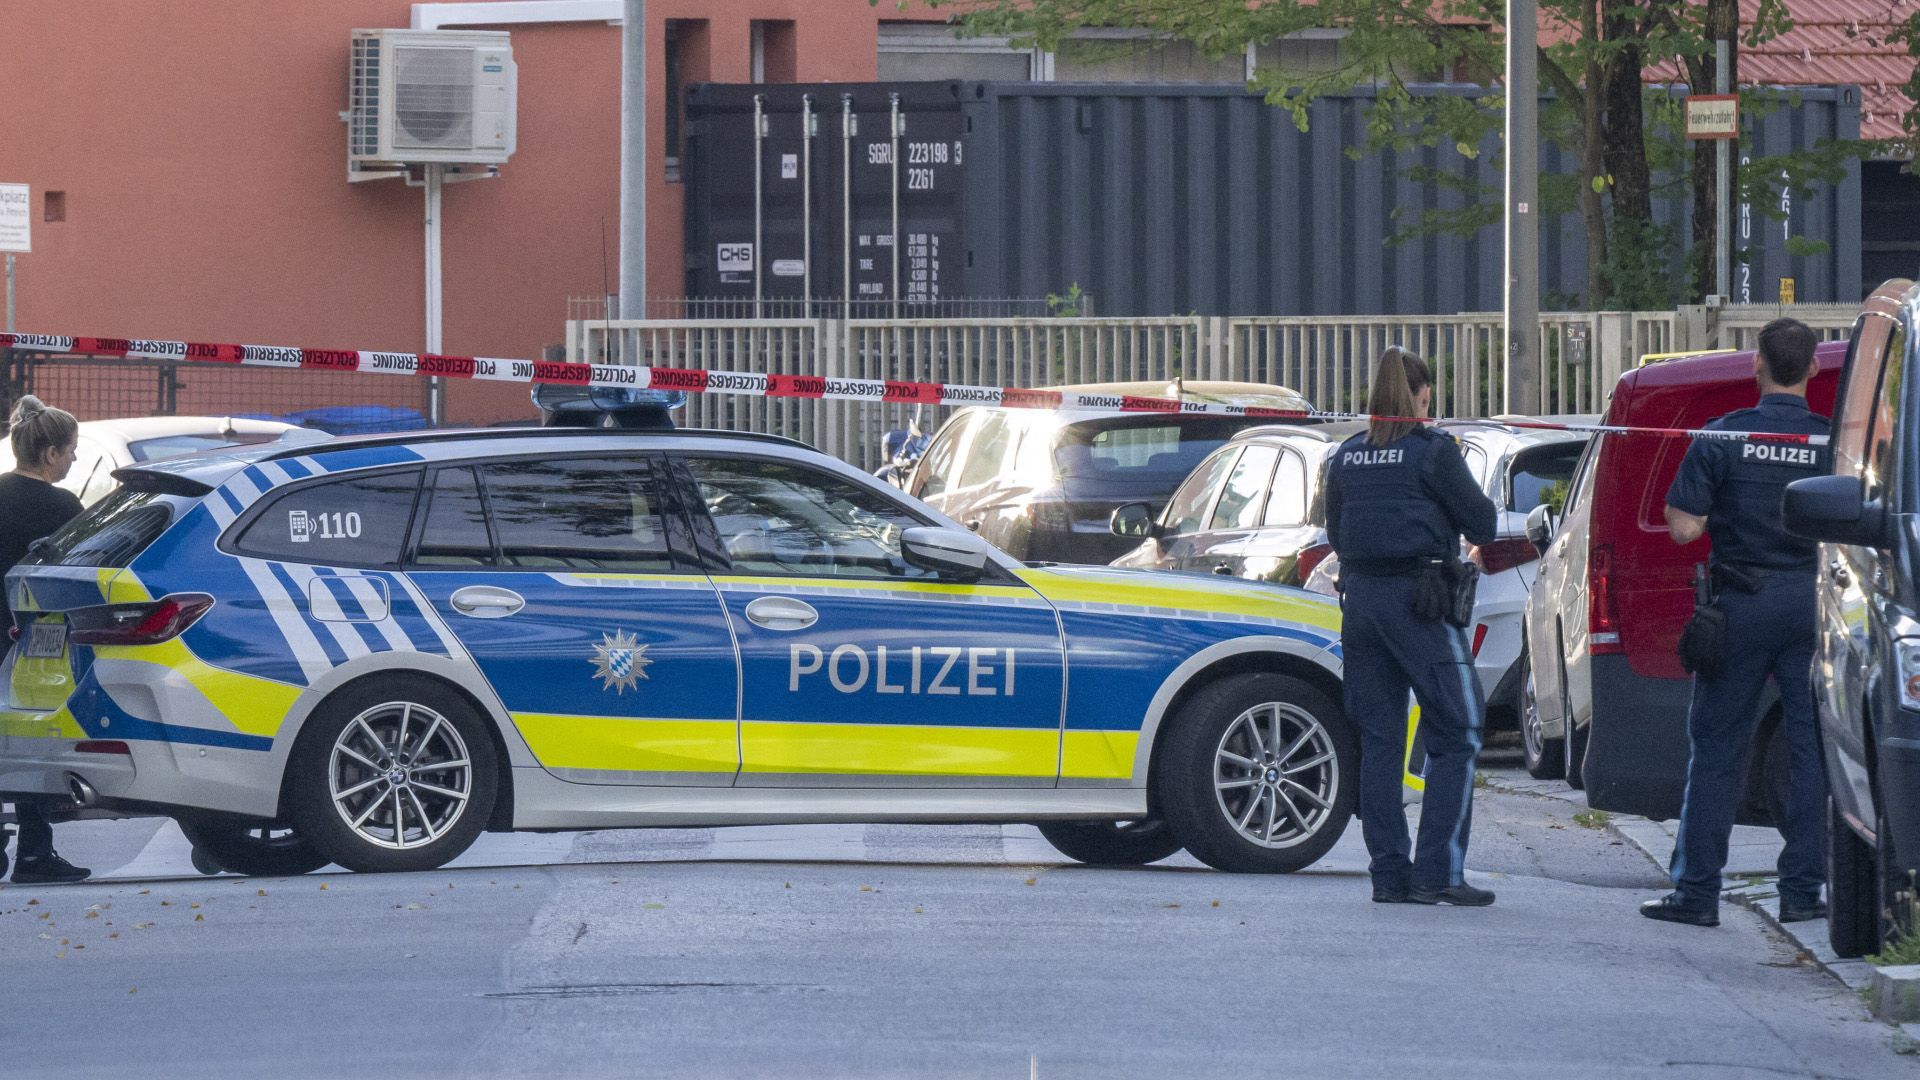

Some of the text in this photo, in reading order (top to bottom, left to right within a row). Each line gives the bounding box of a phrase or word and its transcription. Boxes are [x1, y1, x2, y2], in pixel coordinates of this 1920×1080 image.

[1688, 109, 1735, 125] Feuerwehrzufahrt
[868, 141, 962, 165] SGRU 223198 3
[908, 168, 935, 190] 22G1
[858, 234, 871, 246] MAX
[876, 234, 894, 246] GROSS
[931, 233, 939, 247] kg
[719, 247, 751, 262] CHS
[931, 245, 938, 257] lb
[859, 258, 873, 270] TARE
[931, 257, 939, 271] kg
[931, 269, 938, 281] lb
[859, 282, 884, 294] PAYLOAD
[931, 281, 939, 295] kg
[96, 338, 218, 358] POLIZEIABSPERRUNG
[234, 345, 356, 367] POLIZEIABSPERRUNG
[372, 354, 496, 376] POLIZEIABSPERRUNG
[512, 362, 636, 384] POLIZEIABSPERRUNG
[653, 371, 777, 391] POLIZEIABSPERRUNG
[794, 379, 919, 398] POLIZEIABSPERRUNG
[1343, 448, 1404, 467] POLIZEI
[1743, 443, 1817, 466] POLIZEI
[319, 511, 362, 539] 110
[789, 643, 1015, 697] POLIZEI
